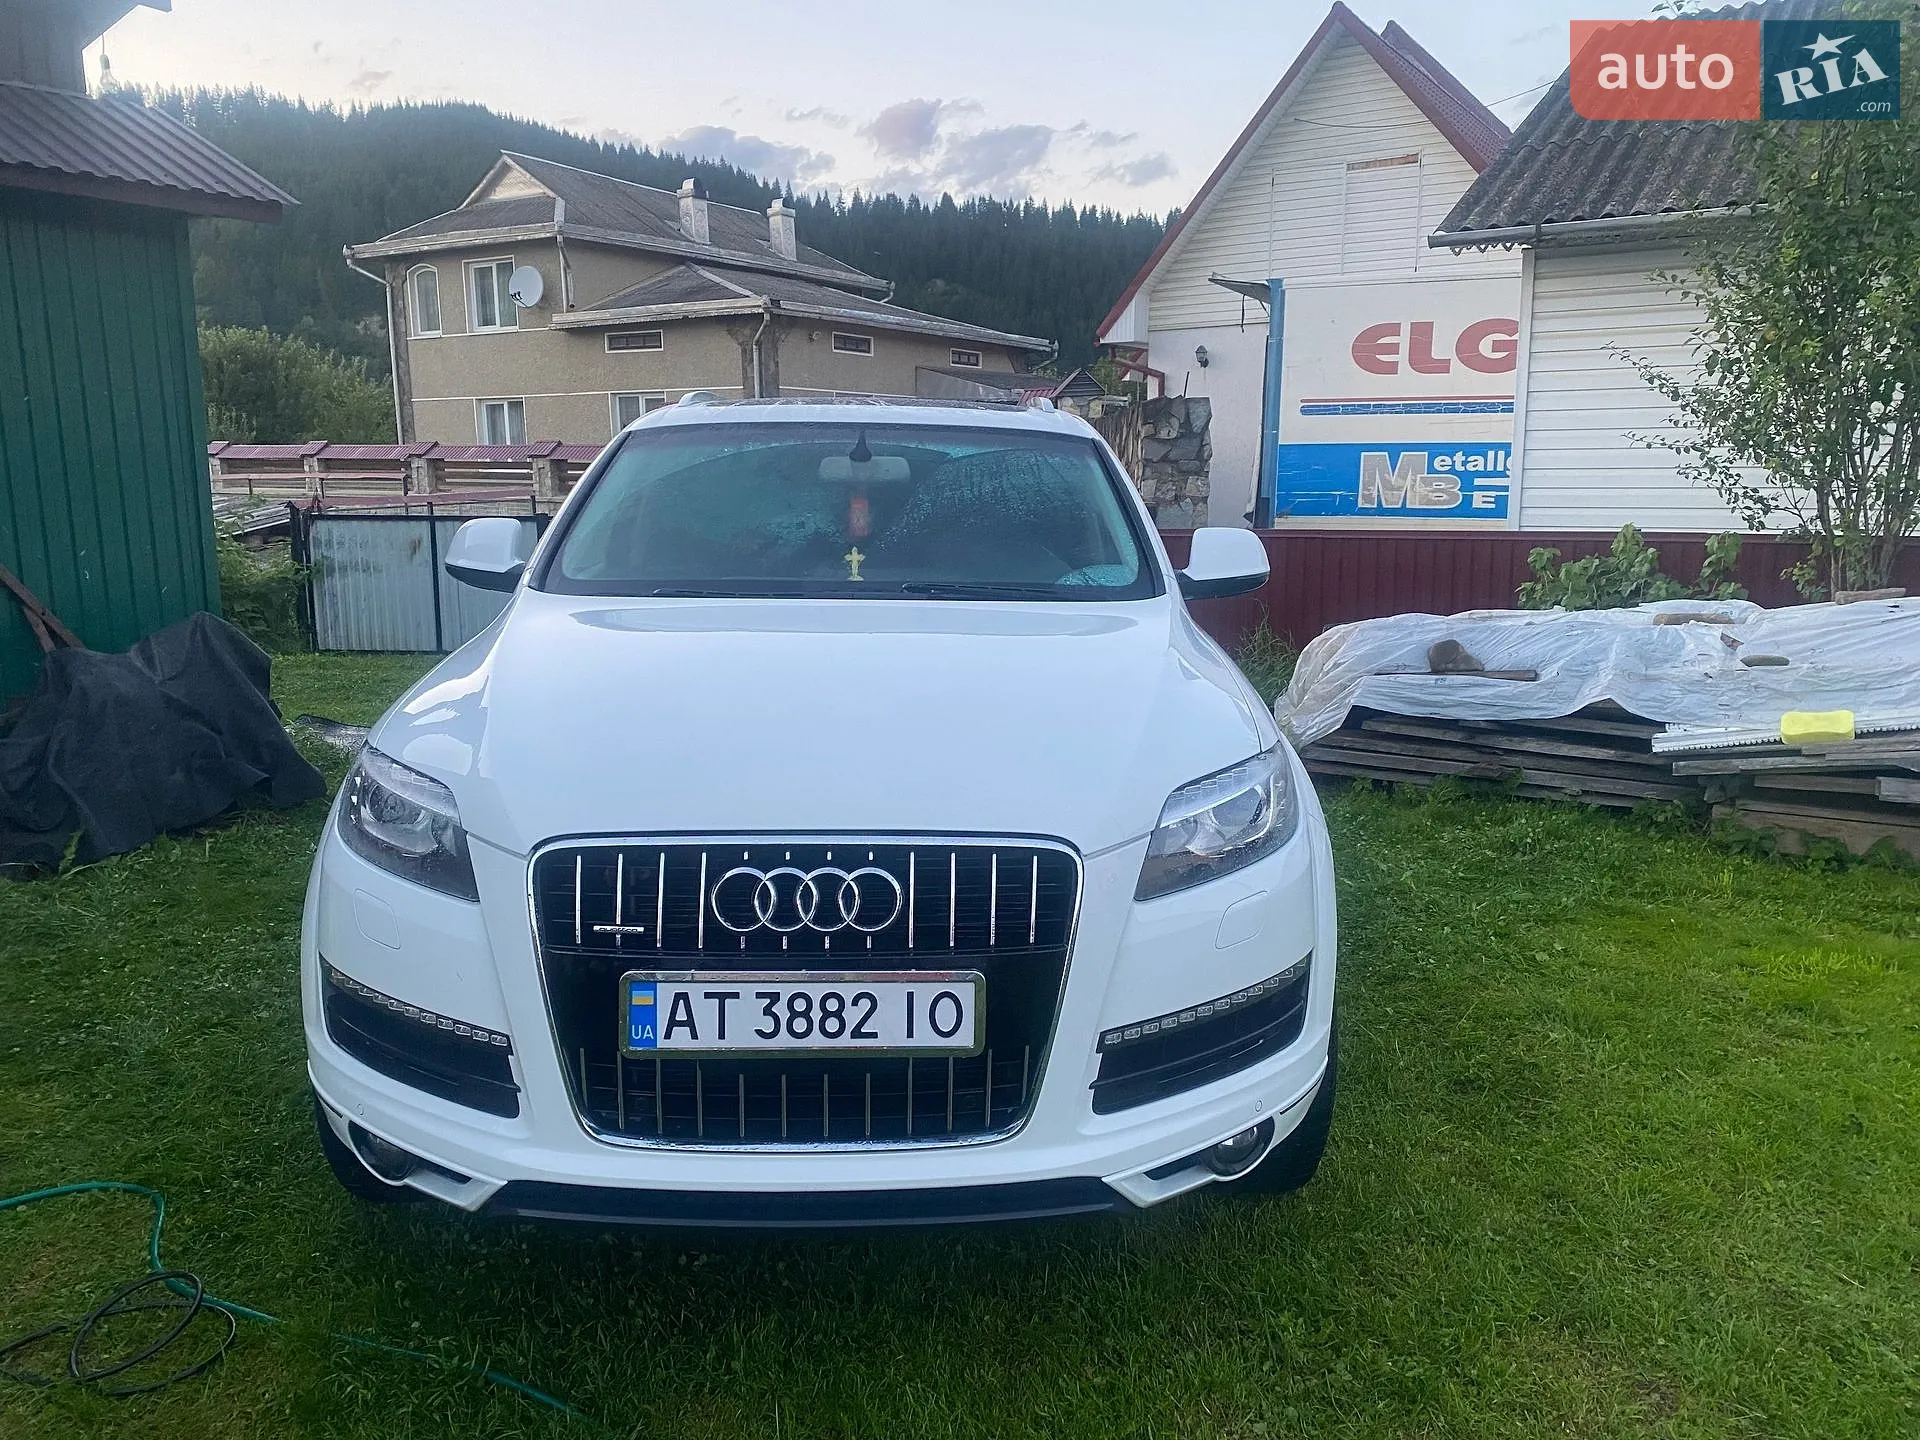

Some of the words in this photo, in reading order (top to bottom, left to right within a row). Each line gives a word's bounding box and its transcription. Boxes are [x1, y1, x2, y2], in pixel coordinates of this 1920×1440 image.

[1351, 318, 1519, 375] ELG
[631, 1025, 654, 1040] UA
[663, 991, 740, 1041] AT
[754, 991, 879, 1040] 3882
[905, 991, 964, 1039] IO
